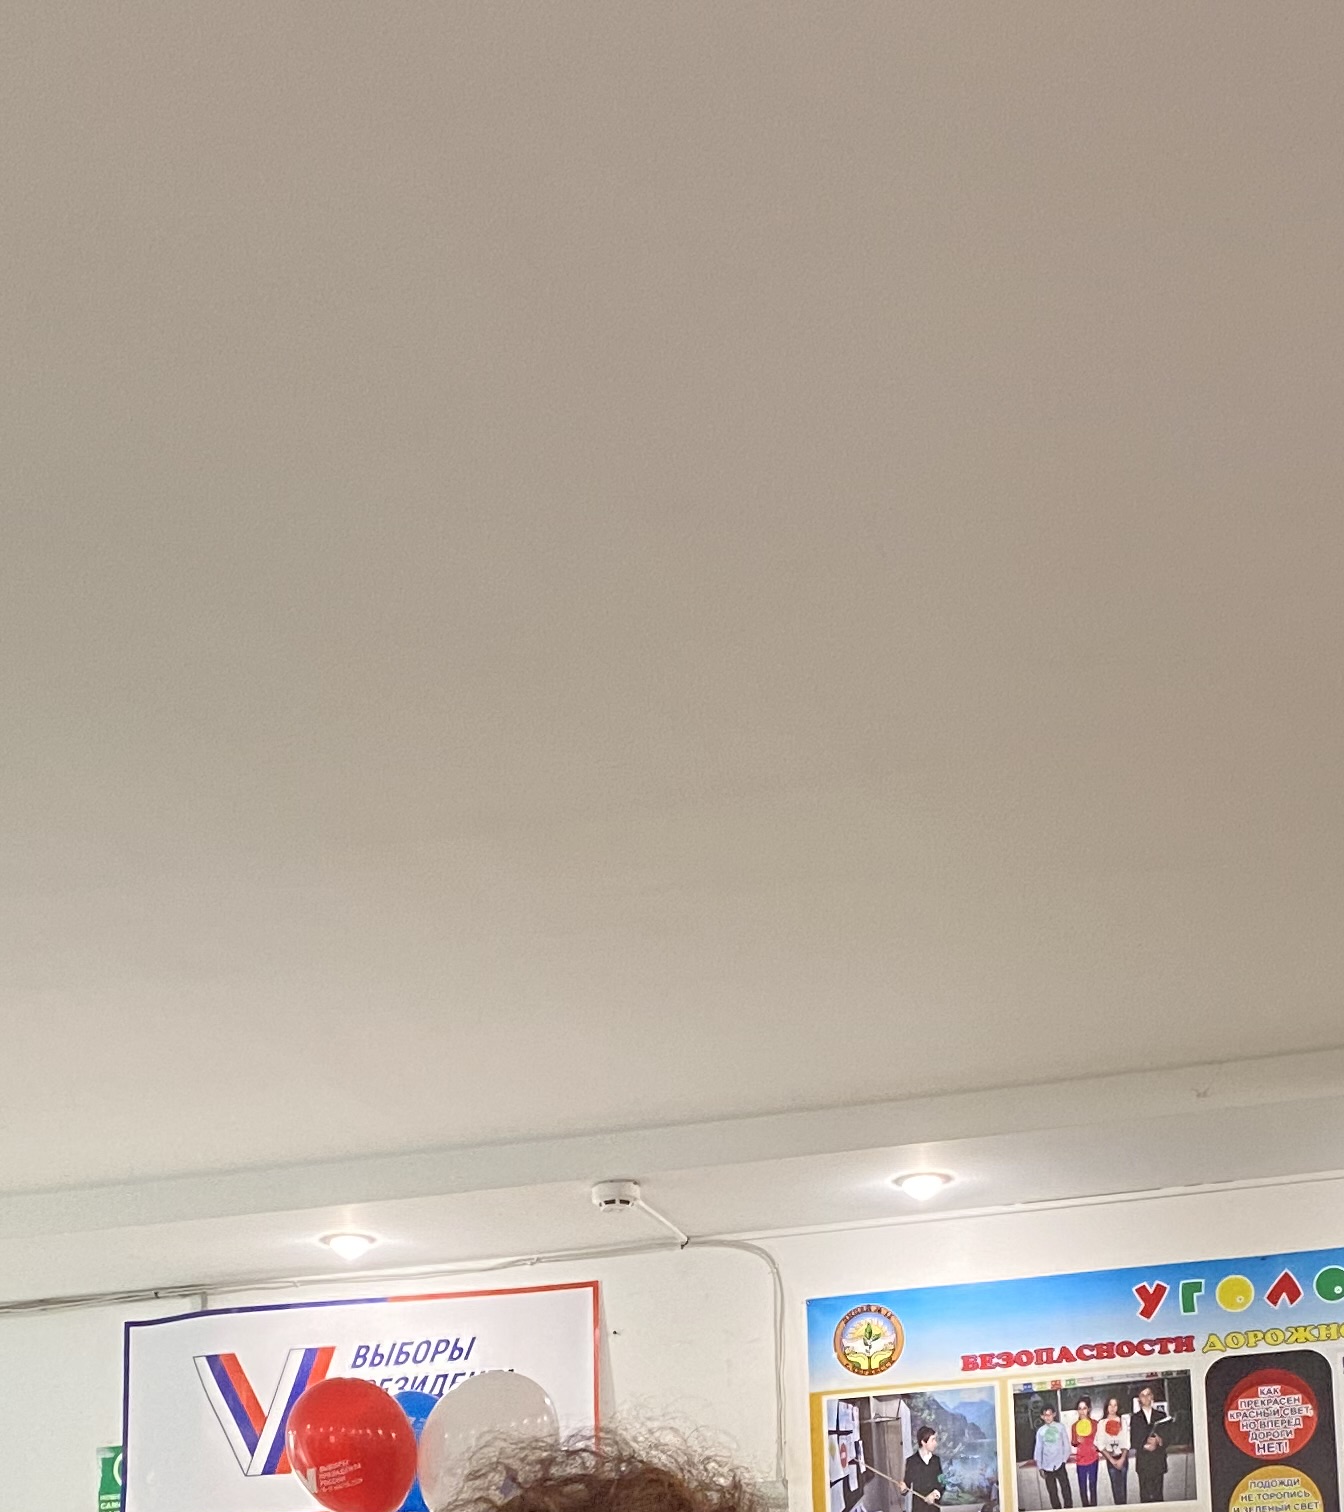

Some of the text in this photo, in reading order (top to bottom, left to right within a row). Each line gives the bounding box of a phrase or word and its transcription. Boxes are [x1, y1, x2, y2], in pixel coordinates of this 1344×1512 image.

[351, 1337, 477, 1369] ВЫБОРЫ
[961, 1335, 1196, 1371] БЕЗОПАСНОСТИ
[1259, 1387, 1279, 1396] КАК
[1239, 1396, 1301, 1409] ПРЕКРАСЕН
[1229, 1408, 1280, 1420] КРАСНЫЙ
[1241, 1420, 1257, 1430] НО
[1250, 1429, 1294, 1442] ДОРОГИ
[1256, 1441, 1289, 1454] НЕТ!
[1249, 1478, 1301, 1490] ПОДОЖДИ
[1240, 1490, 1311, 1503] НЕ ТОРОПИСЬ
[1293, 1501, 1320, 1512] СВЕТ
